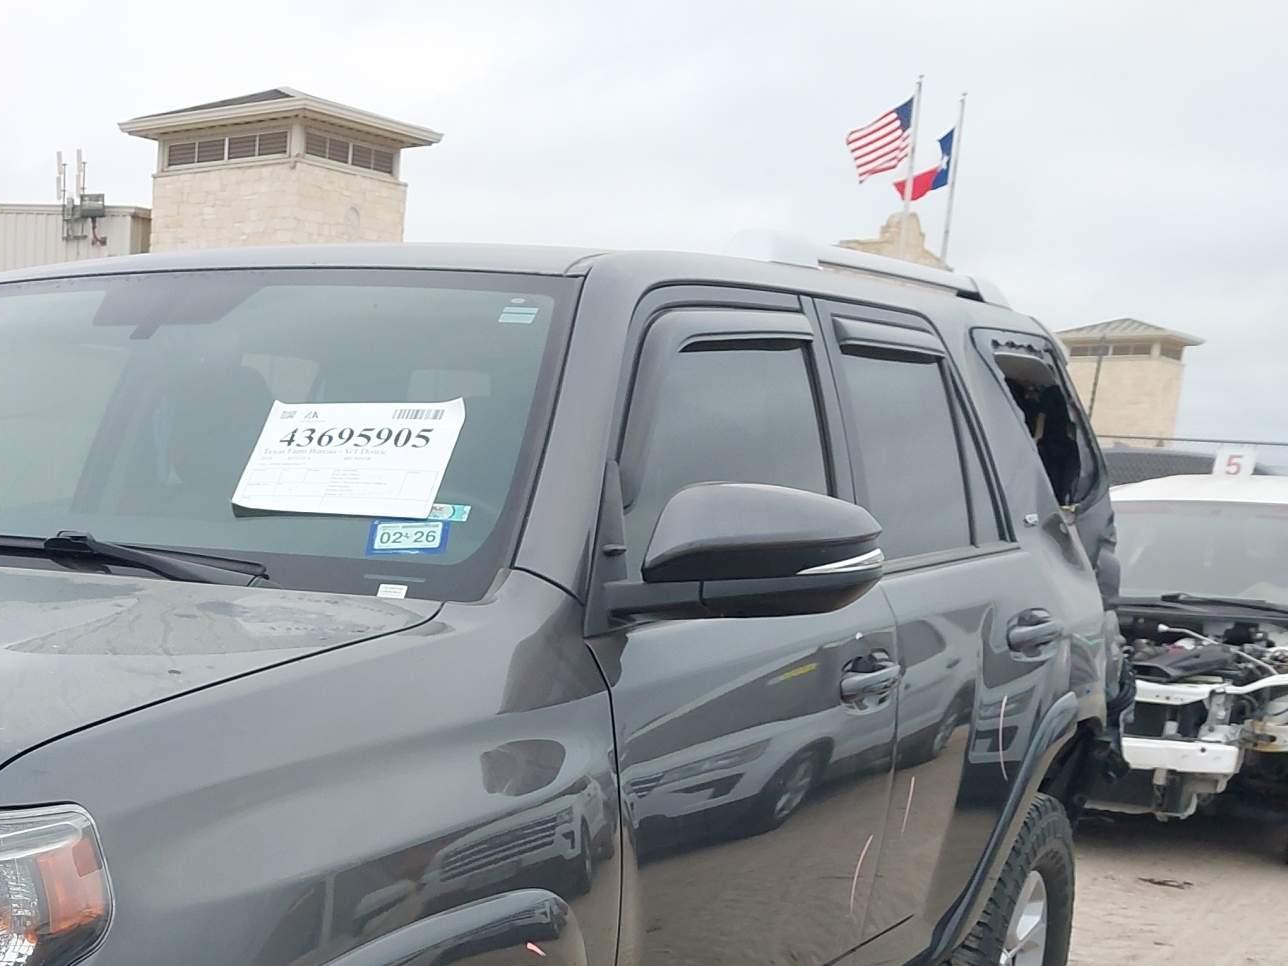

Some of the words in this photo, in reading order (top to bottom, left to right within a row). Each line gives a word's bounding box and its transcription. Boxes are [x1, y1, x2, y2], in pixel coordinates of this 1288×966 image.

[279, 427, 435, 448] 43695905
[1225, 454, 1244, 475] 5
[379, 531, 403, 544] 02
[413, 530, 437, 543] 26
